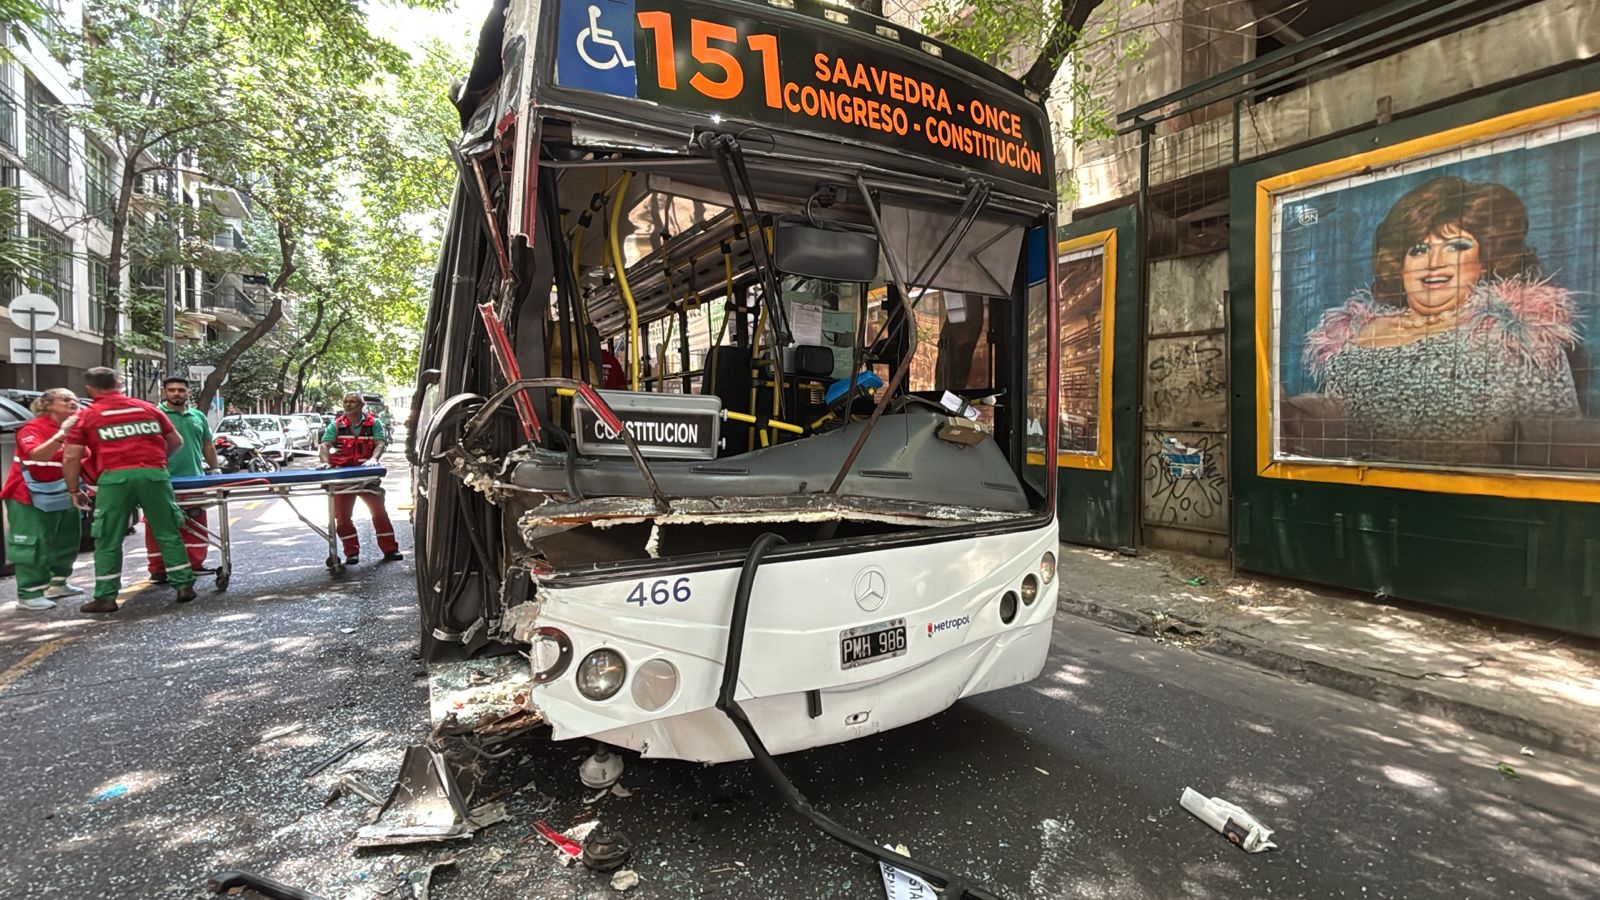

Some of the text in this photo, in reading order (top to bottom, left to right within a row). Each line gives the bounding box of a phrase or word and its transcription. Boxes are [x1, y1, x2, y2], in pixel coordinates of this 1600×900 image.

[637, 11, 783, 109] 151
[814, 53, 952, 115] SAAVEDRA
[970, 100, 1022, 139] ONCE
[784, 82, 909, 136] CONGRESO
[926, 116, 1042, 176] CONSTITUCIÓN
[99, 422, 161, 440] MEDICO
[594, 420, 698, 443] COSTITUCION
[626, 577, 691, 607] 466
[934, 615, 970, 634] Metropol
[843, 629, 905, 662] PMH 986
